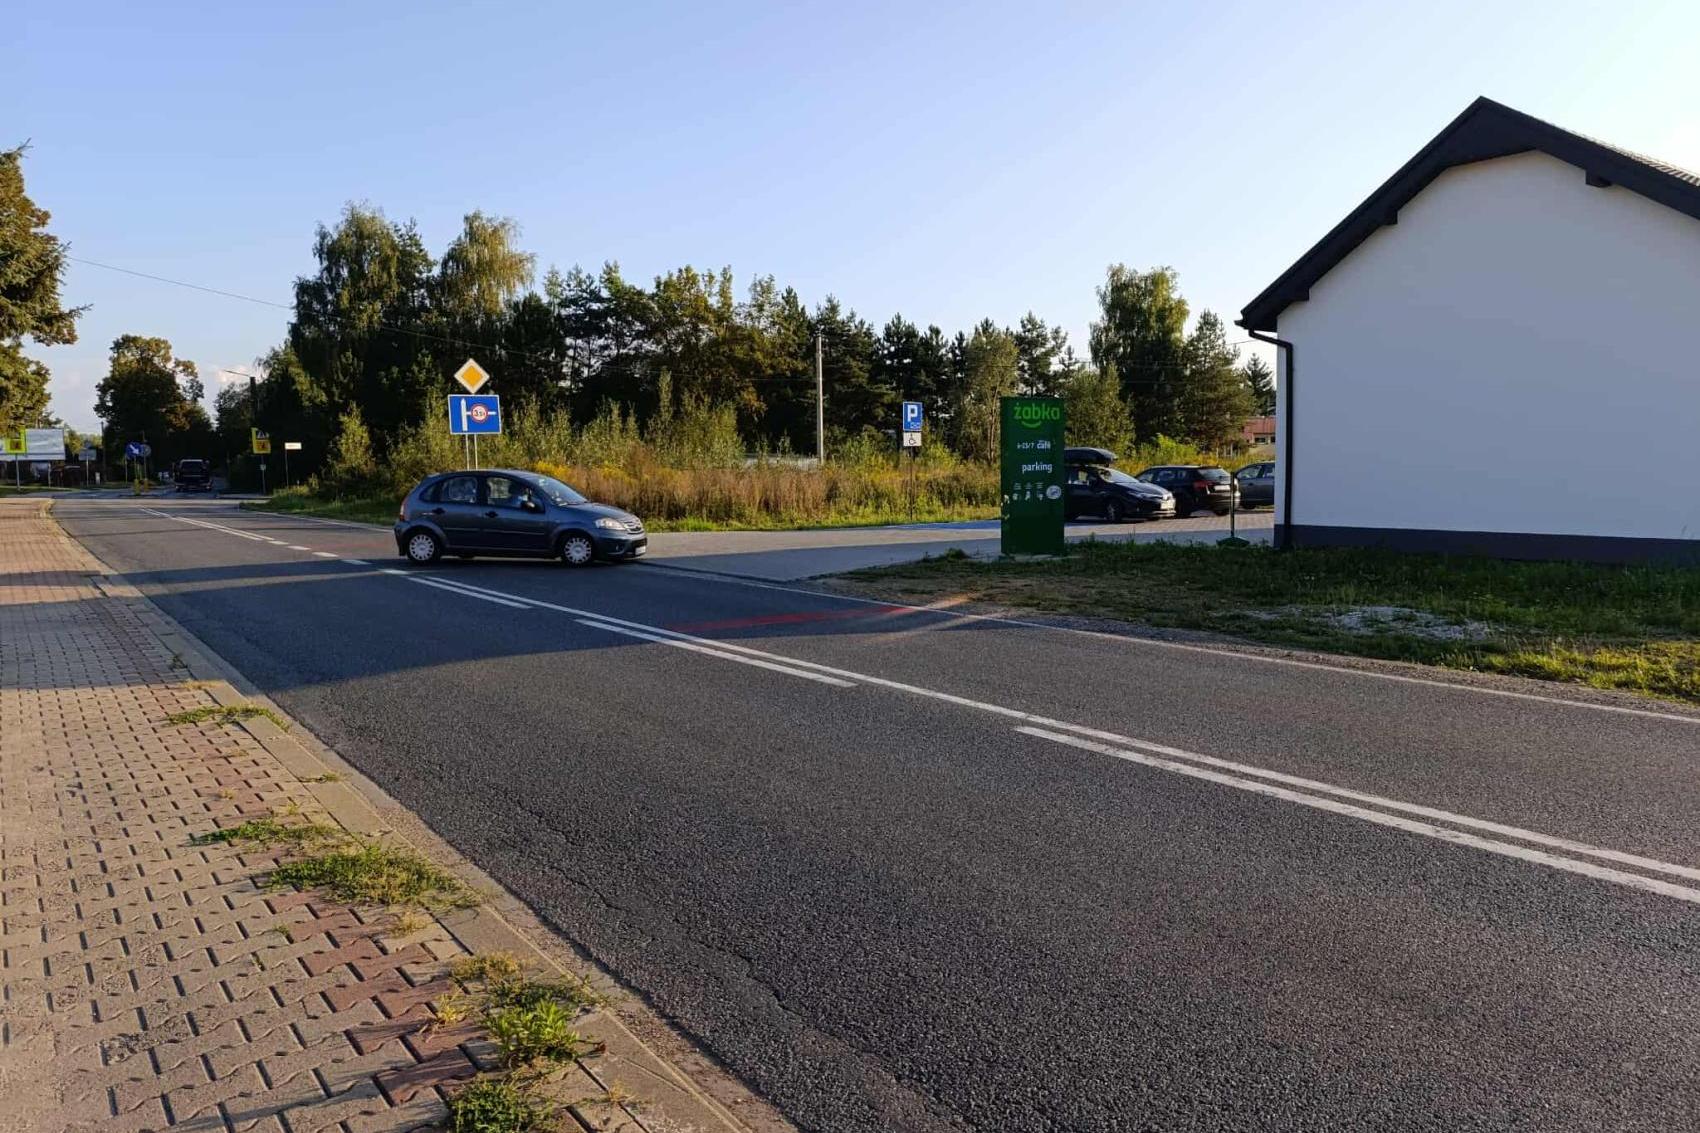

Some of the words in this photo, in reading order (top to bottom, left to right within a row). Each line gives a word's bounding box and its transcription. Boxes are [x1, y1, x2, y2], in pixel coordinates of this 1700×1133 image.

[907, 404, 918, 422] P
[1013, 402, 1060, 420] żabka
[1021, 461, 1053, 474] parking
